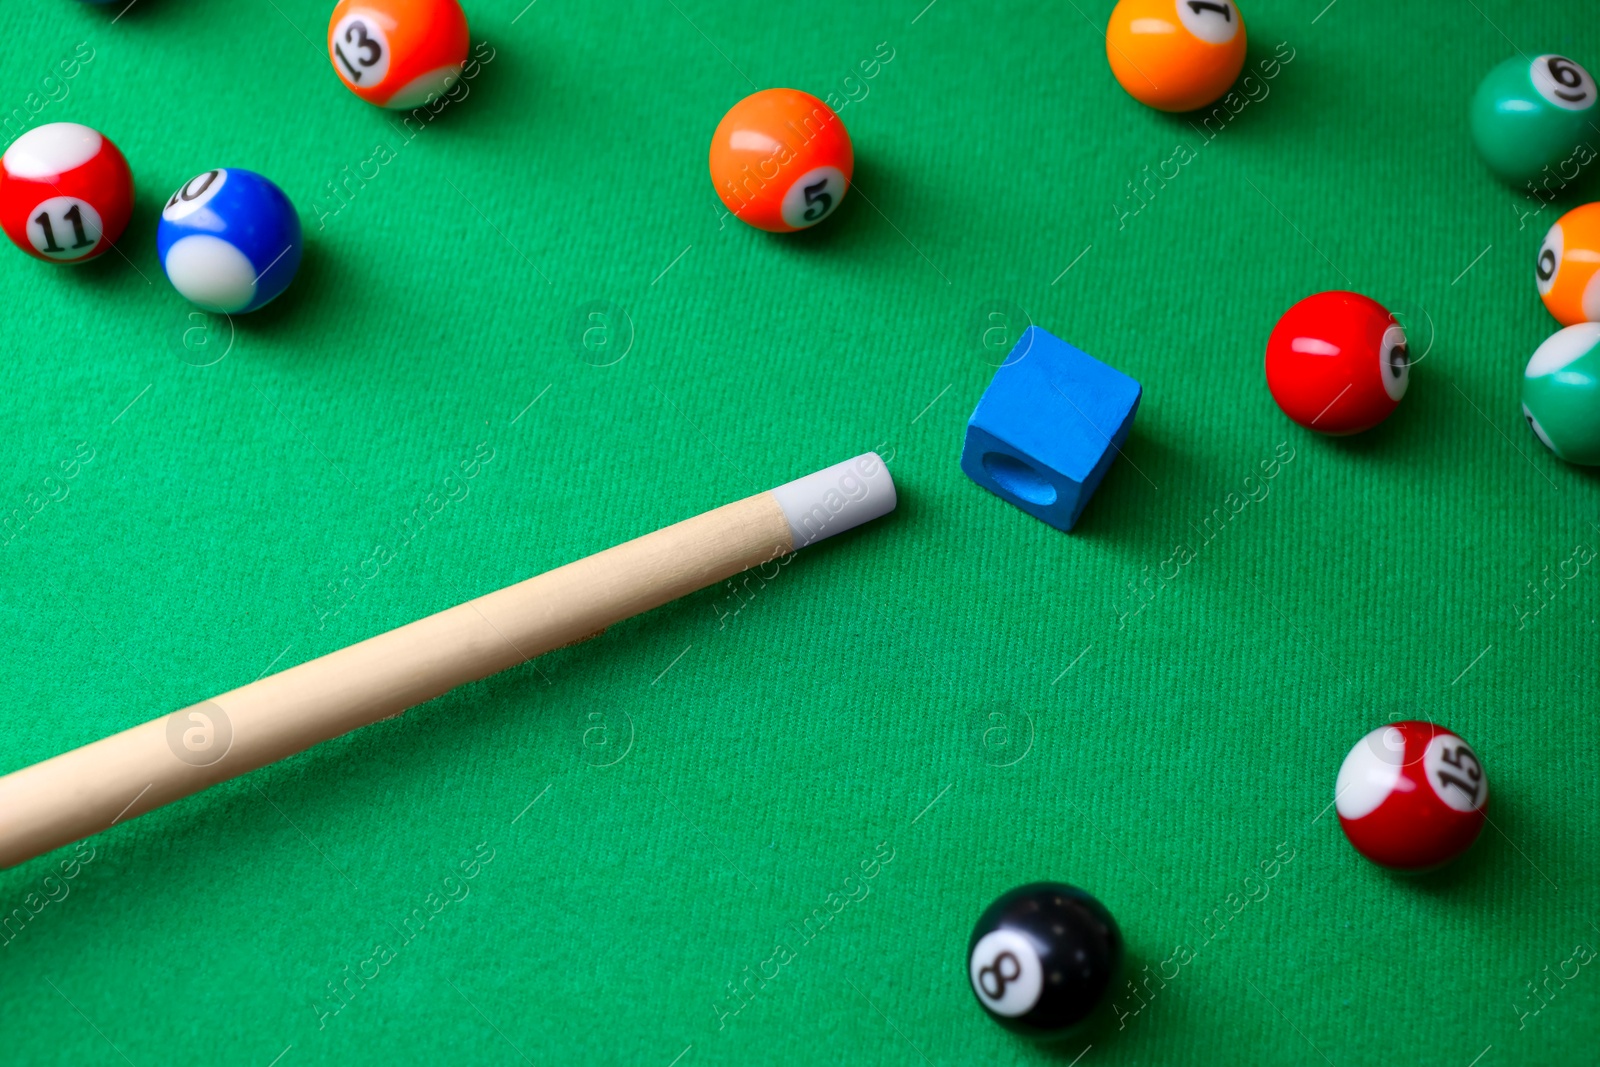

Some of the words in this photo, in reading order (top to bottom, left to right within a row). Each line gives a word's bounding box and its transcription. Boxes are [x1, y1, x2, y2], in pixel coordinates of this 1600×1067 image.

[1186, 0, 1231, 23] 1
[335, 20, 382, 83] 13
[165, 170, 219, 210] 10
[804, 178, 832, 222] 5
[35, 204, 95, 253] 11
[1437, 746, 1481, 807] 15
[979, 951, 1021, 1000] 8
